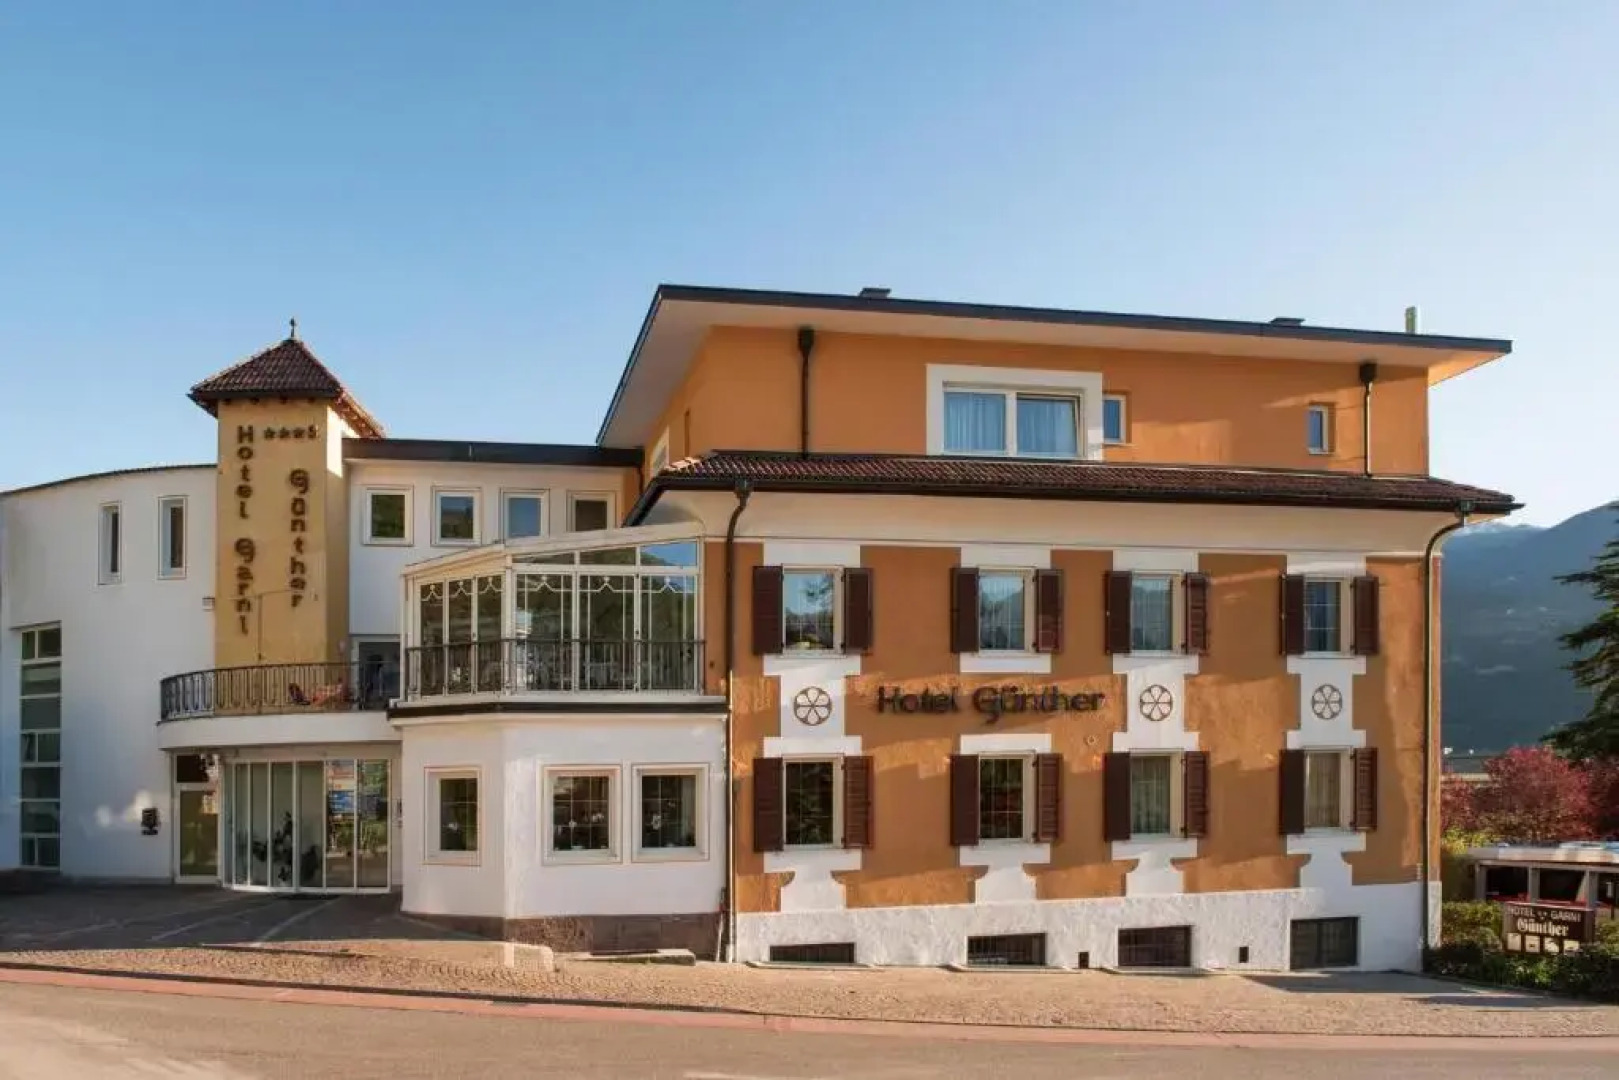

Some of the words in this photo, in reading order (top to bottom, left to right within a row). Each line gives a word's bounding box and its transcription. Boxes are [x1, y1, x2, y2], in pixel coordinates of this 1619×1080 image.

[236, 425, 254, 519] Hotel
[877, 685, 959, 714] Hotel
[971, 685, 1105, 724] Günther
[1506, 904, 1534, 917] HOTEL
[1550, 909, 1581, 922] GARNI
